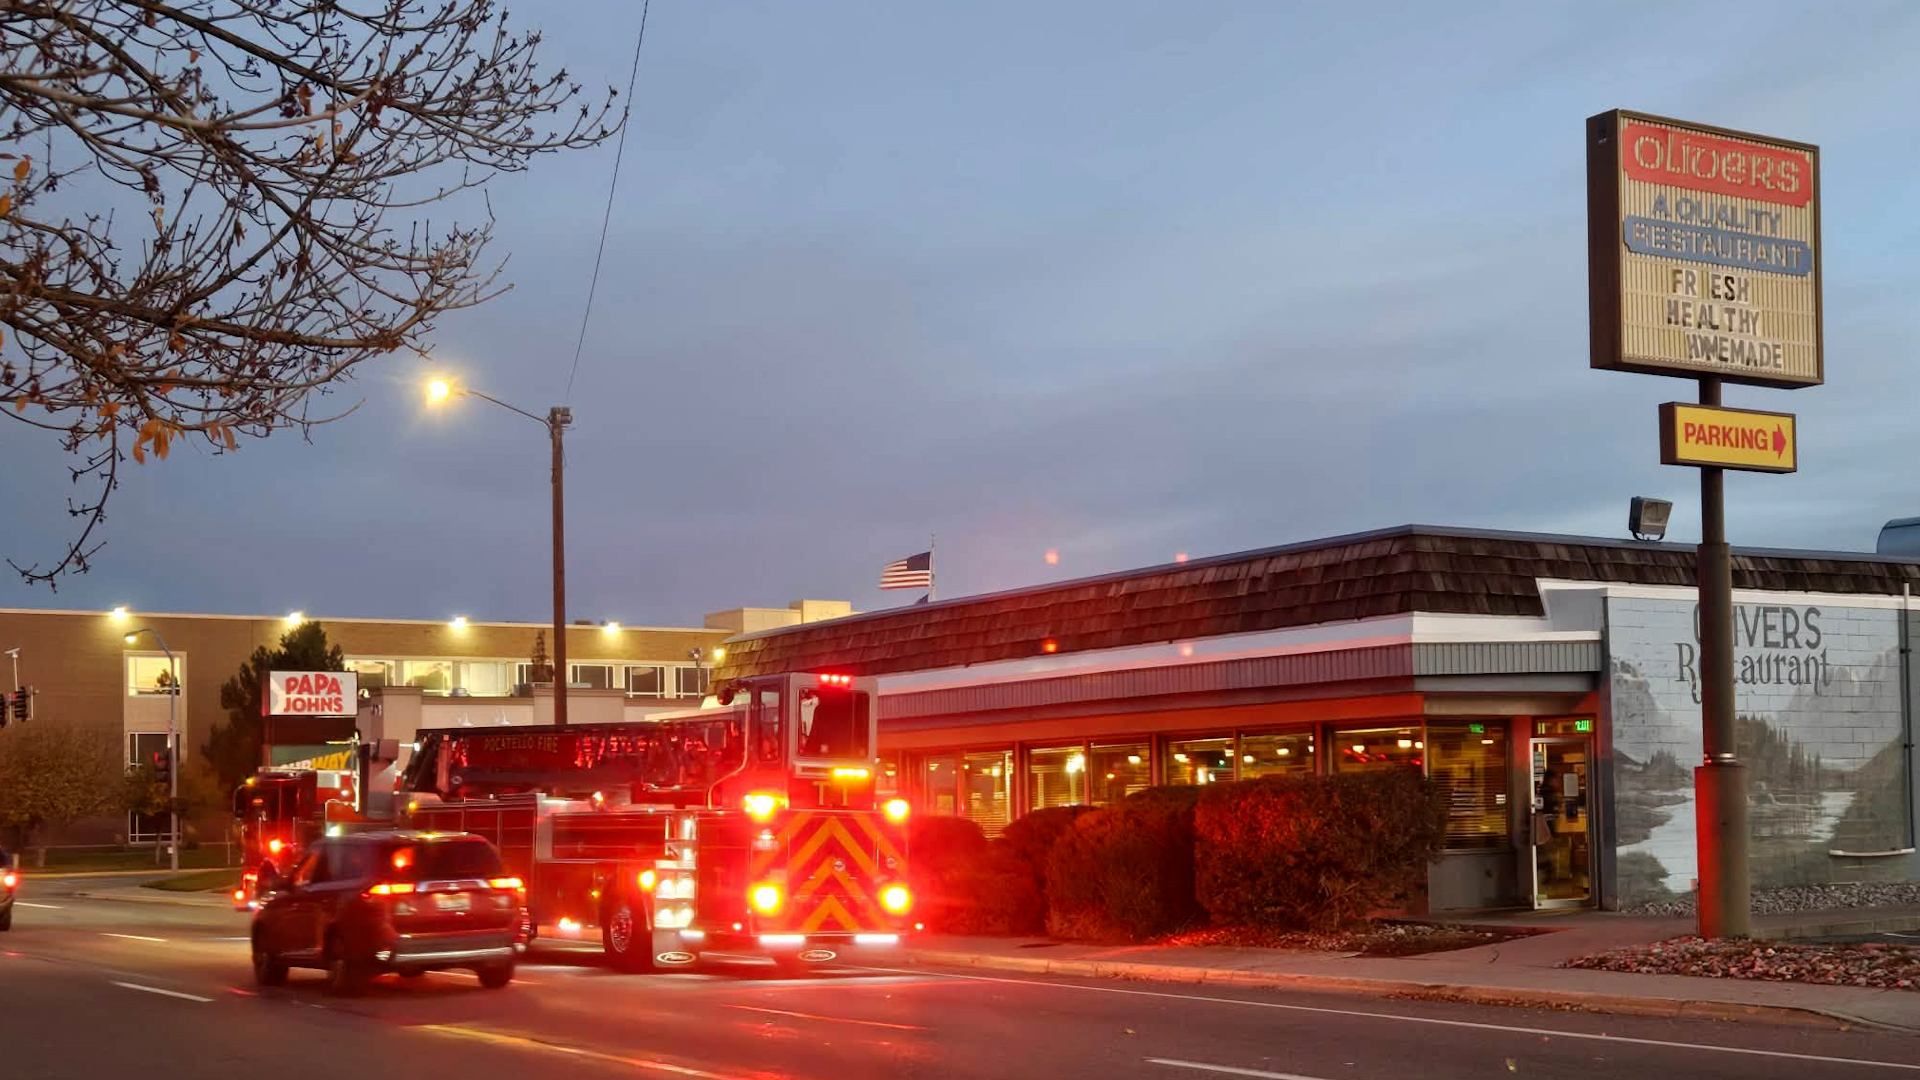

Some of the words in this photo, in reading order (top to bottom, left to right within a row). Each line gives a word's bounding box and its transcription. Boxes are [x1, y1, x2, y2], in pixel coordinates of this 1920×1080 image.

[1652, 193, 1668, 217] A
[1676, 197, 1781, 235] QUALITY
[1633, 223, 1801, 269] RESTAURANT
[1666, 299, 1759, 336] HEALTHY
[1684, 422, 1768, 451] PARKING
[1693, 602, 1822, 650] IVERS
[285, 673, 342, 695] PAPA
[1675, 642, 1834, 704] Raurant
[284, 697, 344, 713] JOHNS
